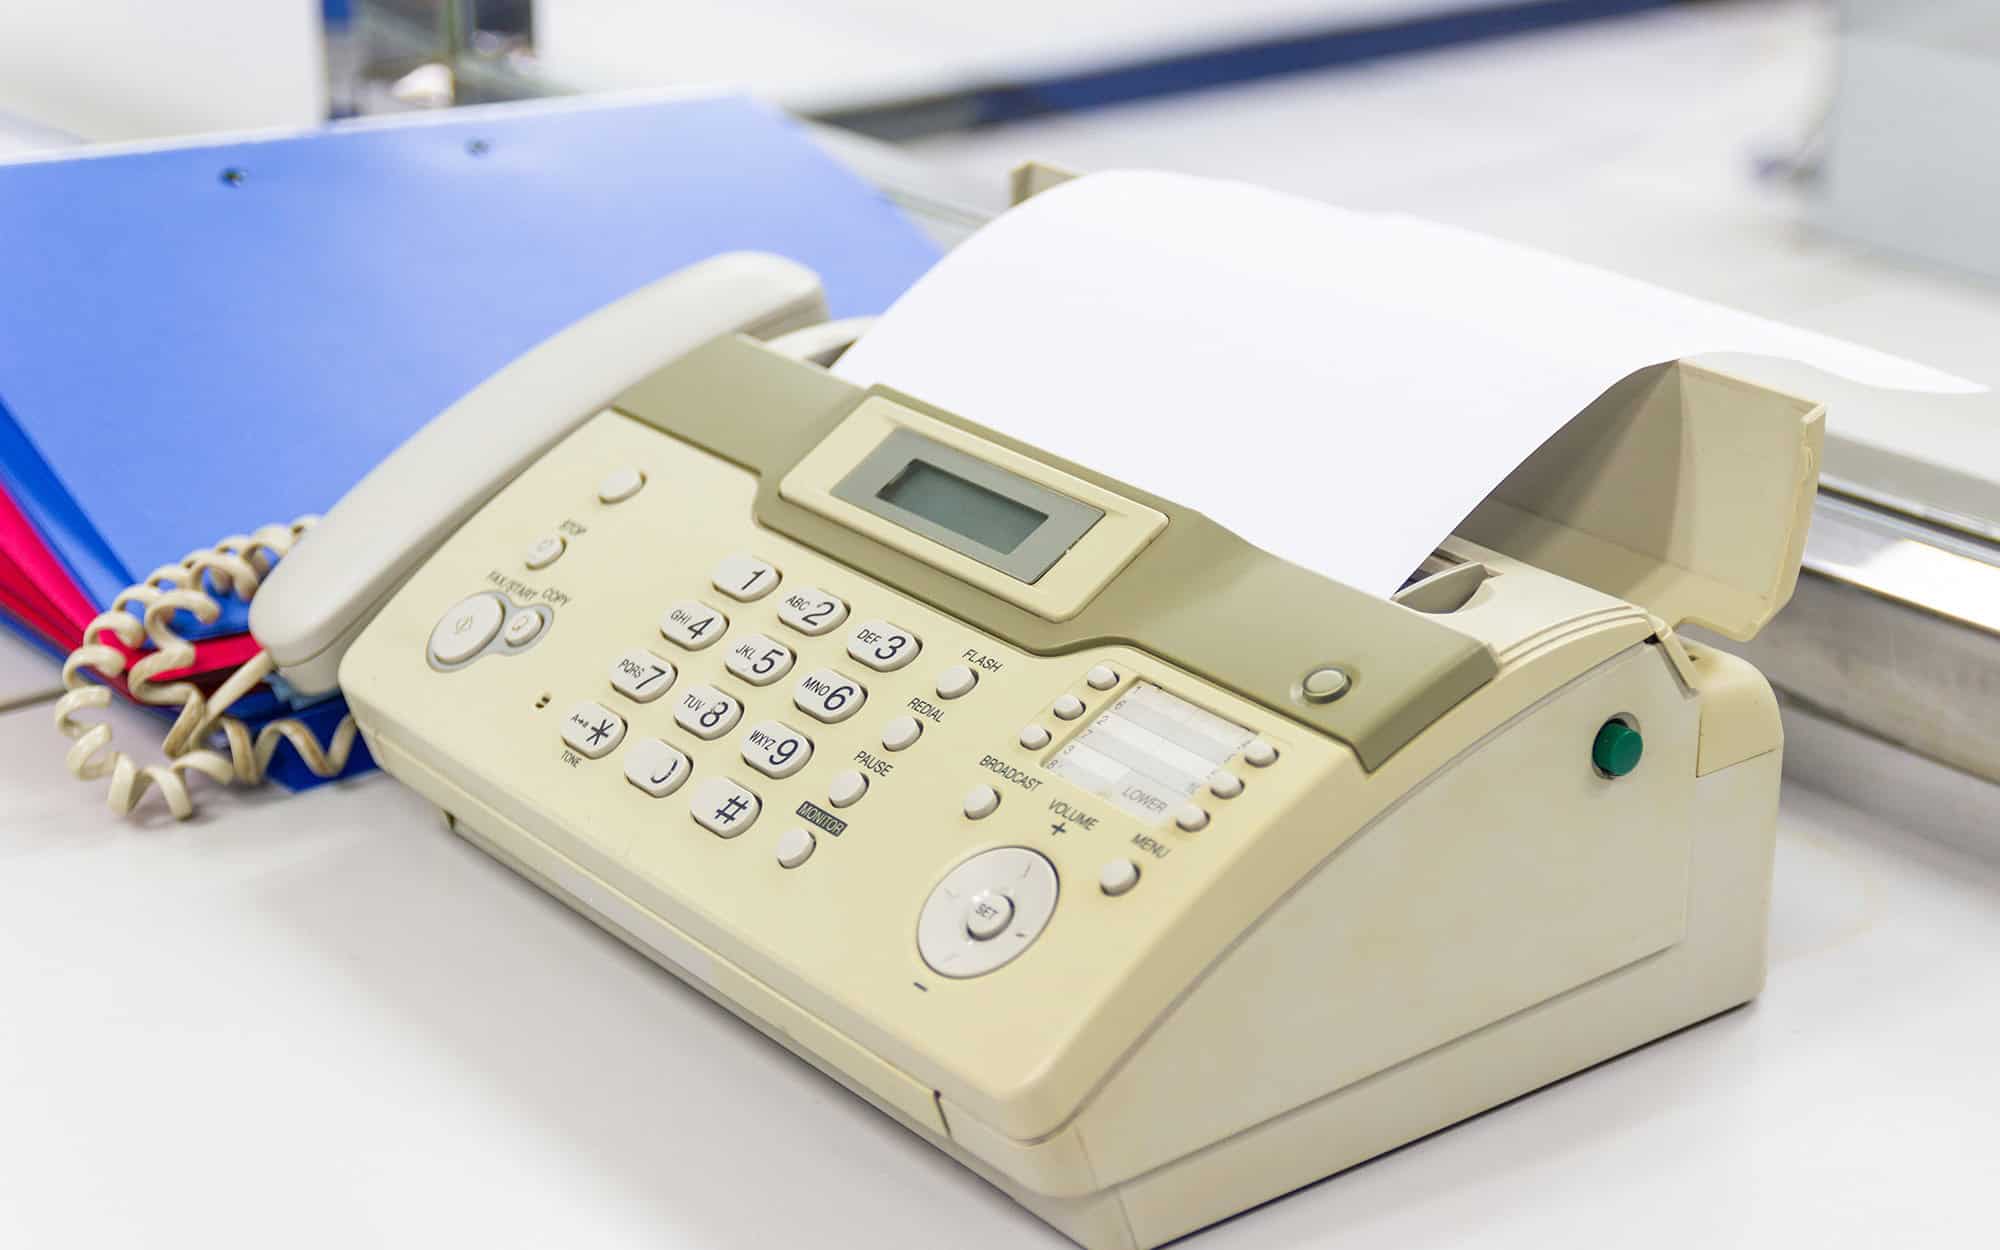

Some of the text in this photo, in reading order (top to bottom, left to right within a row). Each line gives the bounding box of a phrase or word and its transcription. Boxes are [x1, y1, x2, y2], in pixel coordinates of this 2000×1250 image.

[740, 569, 766, 591] 1
[670, 609, 715, 640] GHI 4
[785, 595, 835, 626] ABC 2
[735, 643, 784, 674] JKL 5
[856, 628, 906, 660] DEF 3
[961, 648, 1004, 673] FLASH
[635, 665, 666, 690] 7
[801, 676, 855, 711] MNO 6
[683, 694, 729, 727] TUV 8
[906, 697, 945, 723] REDIAL
[749, 729, 799, 765] WXYZ 9
[853, 750, 894, 777] PAUSE
[979, 754, 1044, 792] BROADCAST
[1048, 798, 1100, 831] VOLUME
[1121, 785, 1169, 814] LOWER
[798, 802, 846, 836] MONITOR
[1130, 833, 1172, 859] MENU
[975, 903, 999, 920] SET
